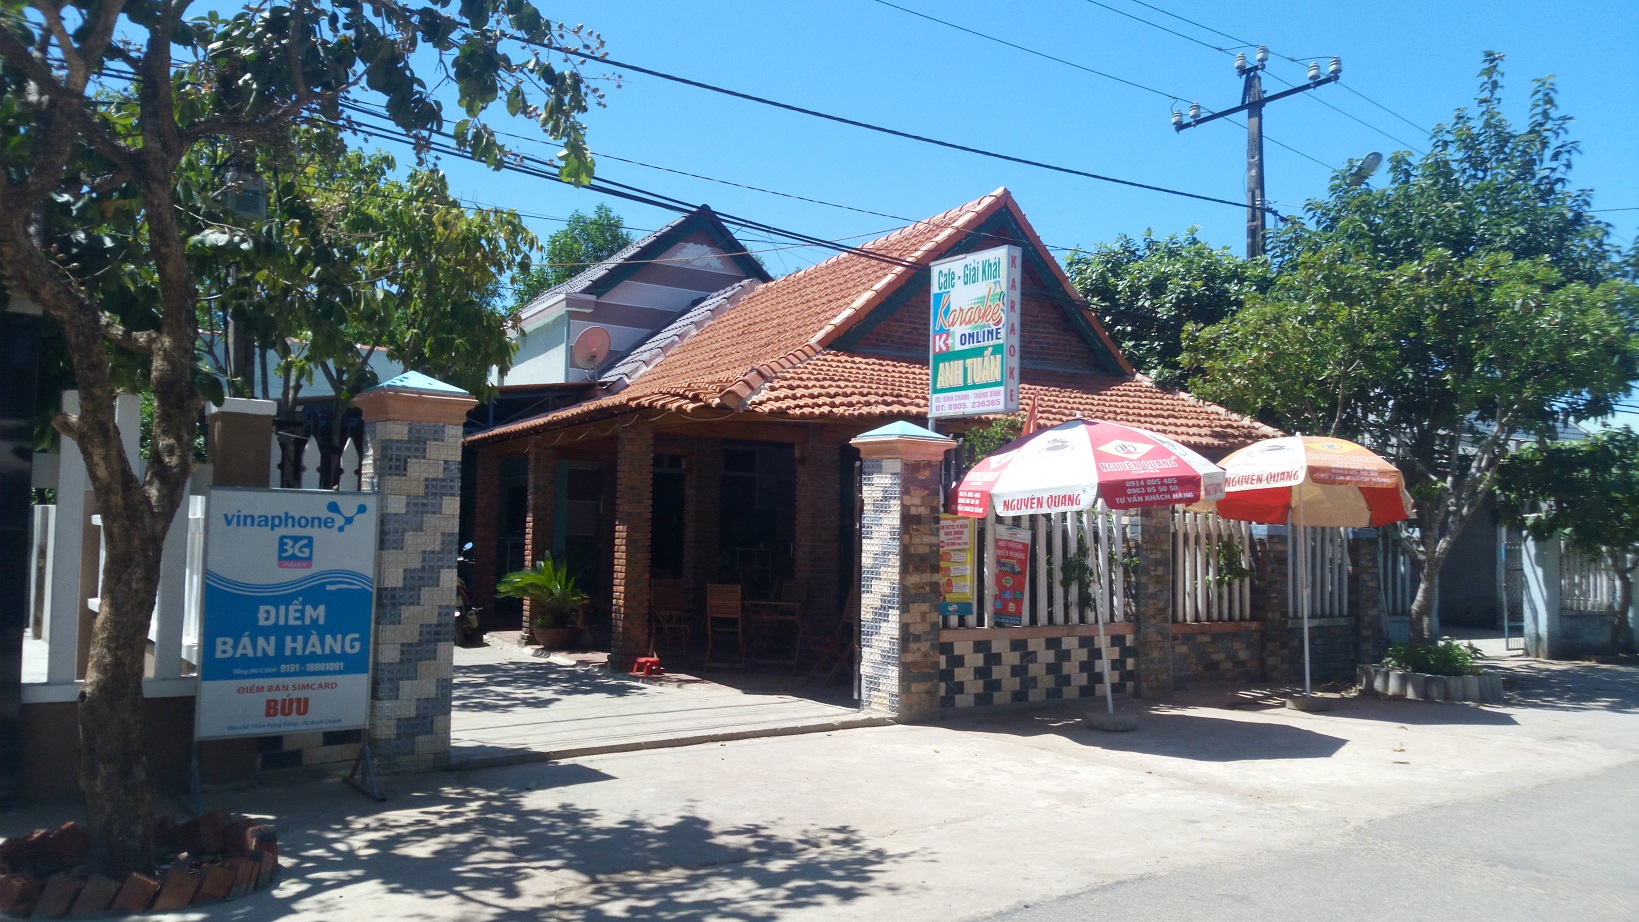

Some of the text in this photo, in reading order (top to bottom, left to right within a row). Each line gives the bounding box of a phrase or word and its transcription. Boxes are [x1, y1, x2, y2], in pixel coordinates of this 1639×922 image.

[937, 268, 956, 291] Cafe
[963, 259, 979, 286] Giải
[981, 255, 1001, 283] Khát
[935, 287, 1002, 330] Karaoke
[959, 327, 1002, 347] ONLINE
[1008, 255, 1017, 402] KARAOKE
[935, 334, 953, 353] K+
[936, 347, 1002, 389] ANH TUẤN
[1265, 469, 1300, 484] QUANG
[1002, 493, 1082, 512] NGUYÊN QUANG
[223, 510, 335, 531] vinaphone
[281, 538, 310, 558] 3G
[257, 597, 326, 626] ĐIỂM
[215, 630, 361, 659] BÁN HÀNG
[280, 664, 299, 673] 9191
[237, 682, 338, 694] ĐIỂM BÁN SIMCARD
[265, 693, 310, 718] BỬU
